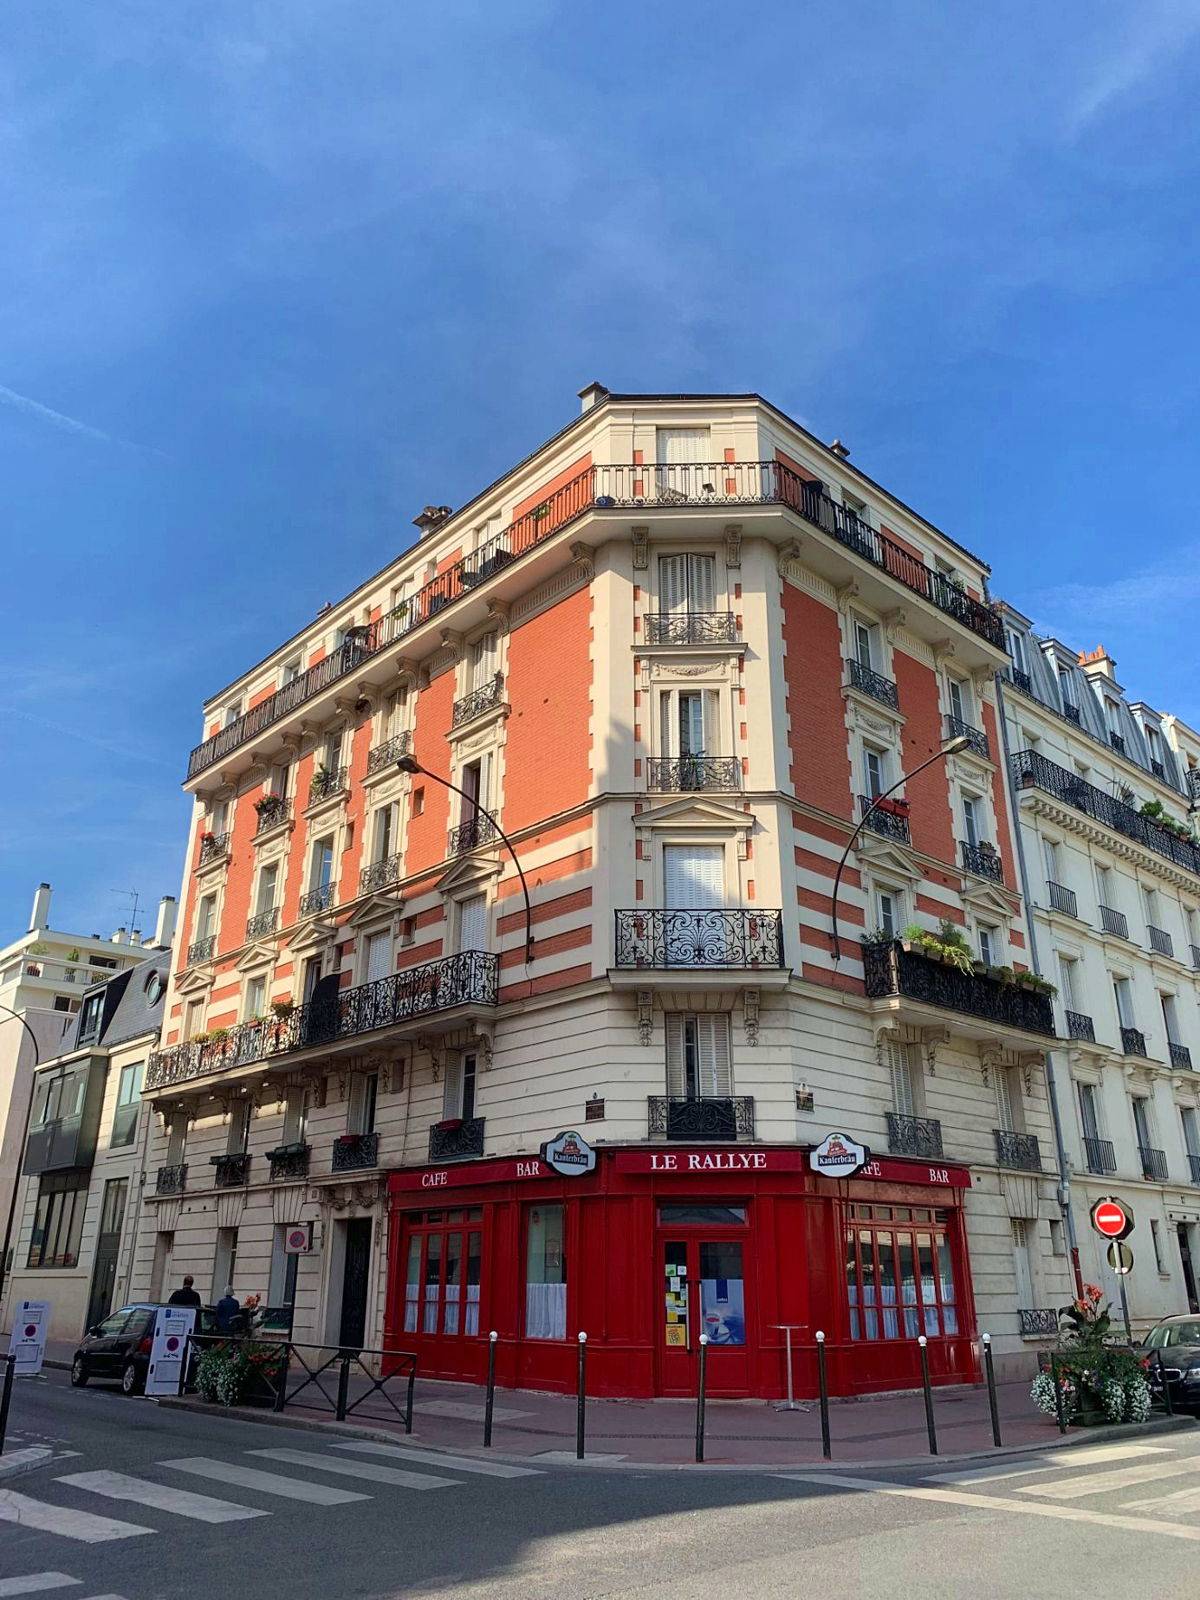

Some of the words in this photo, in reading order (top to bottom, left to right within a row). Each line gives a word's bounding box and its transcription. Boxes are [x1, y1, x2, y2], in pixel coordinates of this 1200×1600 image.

[650, 1154, 678, 1170] LE
[687, 1153, 767, 1170] RALLYE
[421, 1171, 448, 1187] CAFE
[516, 1161, 540, 1177] BAR
[928, 1168, 950, 1184] BAR
